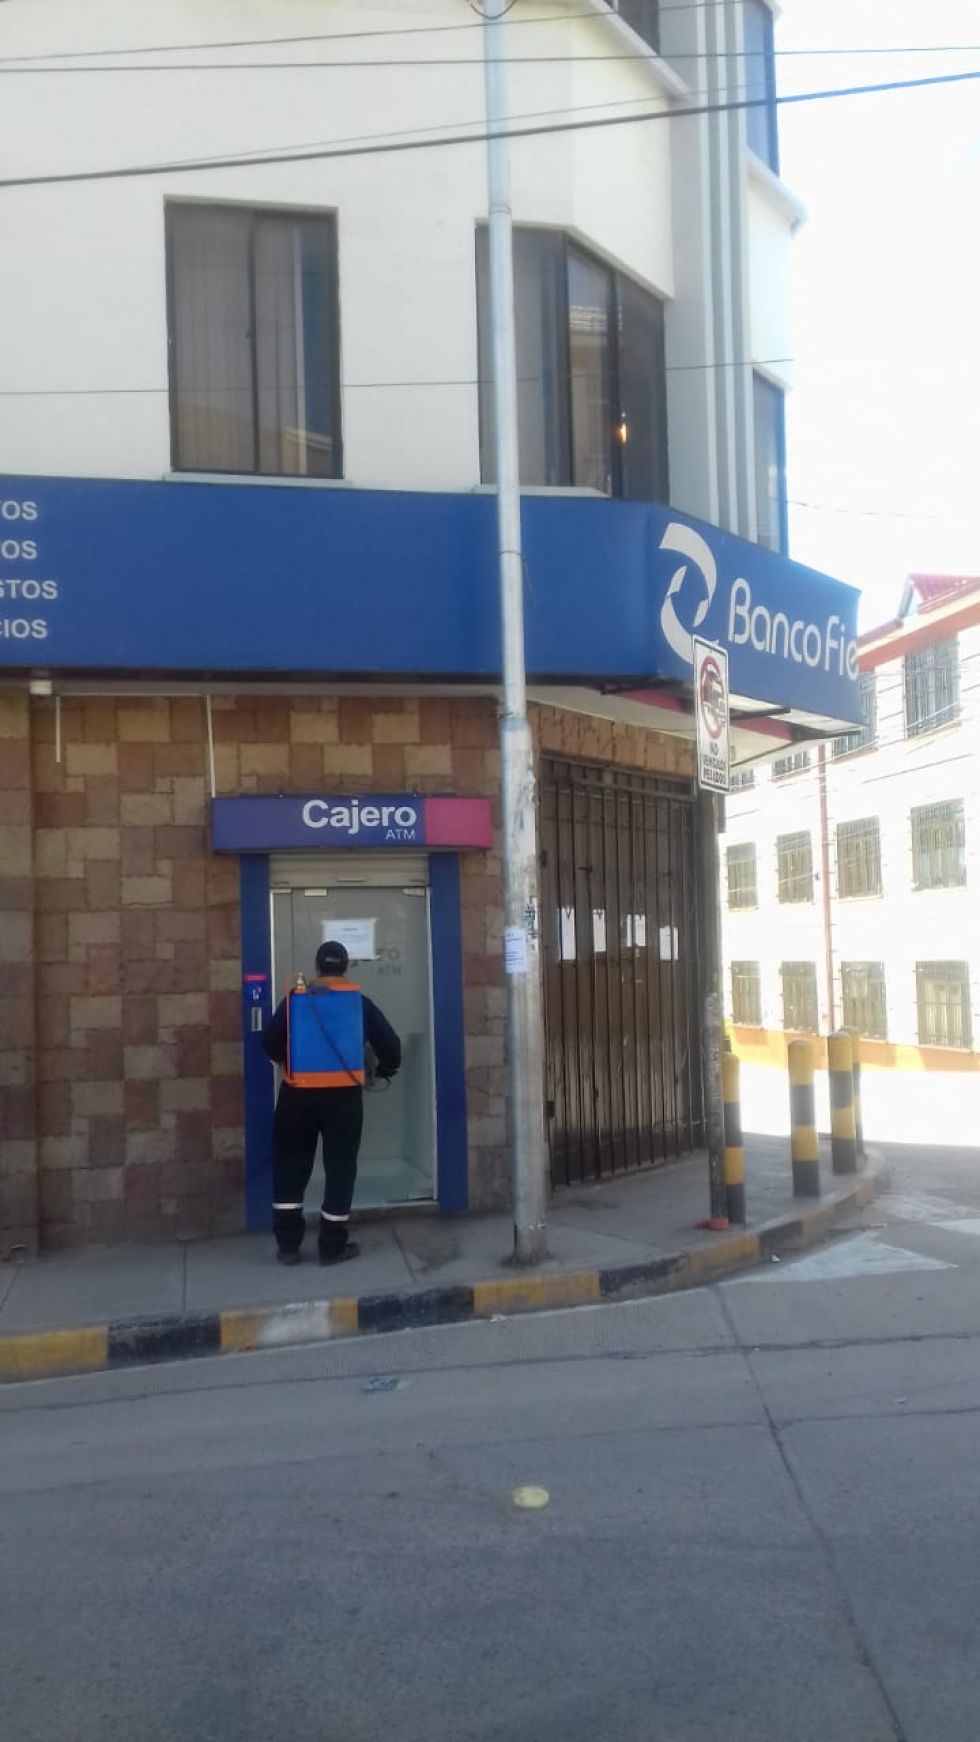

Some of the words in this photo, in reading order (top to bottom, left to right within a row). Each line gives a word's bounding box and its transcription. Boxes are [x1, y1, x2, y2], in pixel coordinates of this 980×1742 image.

[0, 500, 38, 521] OS
[0, 618, 48, 639] IOS
[302, 799, 417, 834] Cajero
[385, 829, 415, 840] ATM
